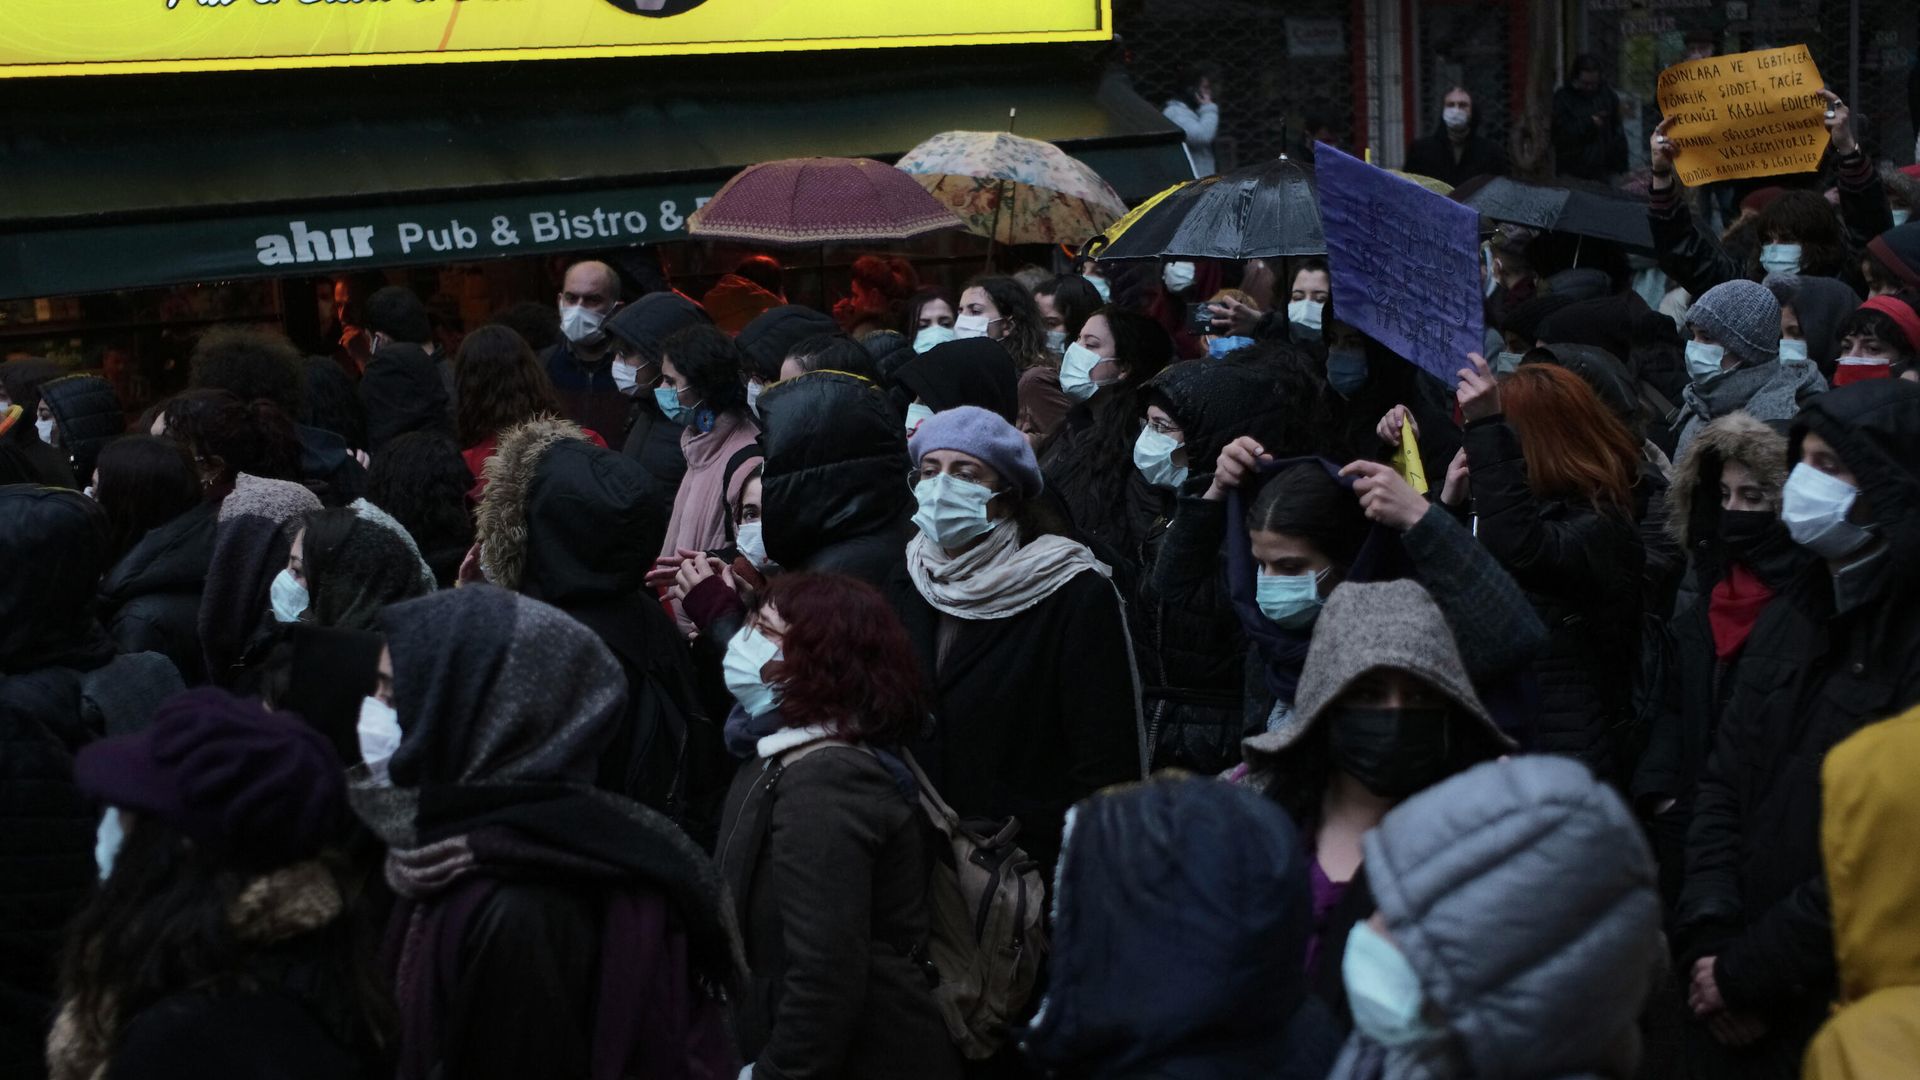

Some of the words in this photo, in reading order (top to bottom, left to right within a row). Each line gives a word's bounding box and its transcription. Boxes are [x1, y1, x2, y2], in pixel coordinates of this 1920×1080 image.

[1659, 64, 1721, 89] ADINLARA
[1730, 60, 1744, 73] VE
[1769, 71, 1803, 89] TACİZ
[1727, 101, 1775, 120] KABUL
[397, 219, 478, 254] Pub
[490, 215, 520, 247] &
[529, 207, 648, 243] Bistro
[659, 200, 684, 232] &
